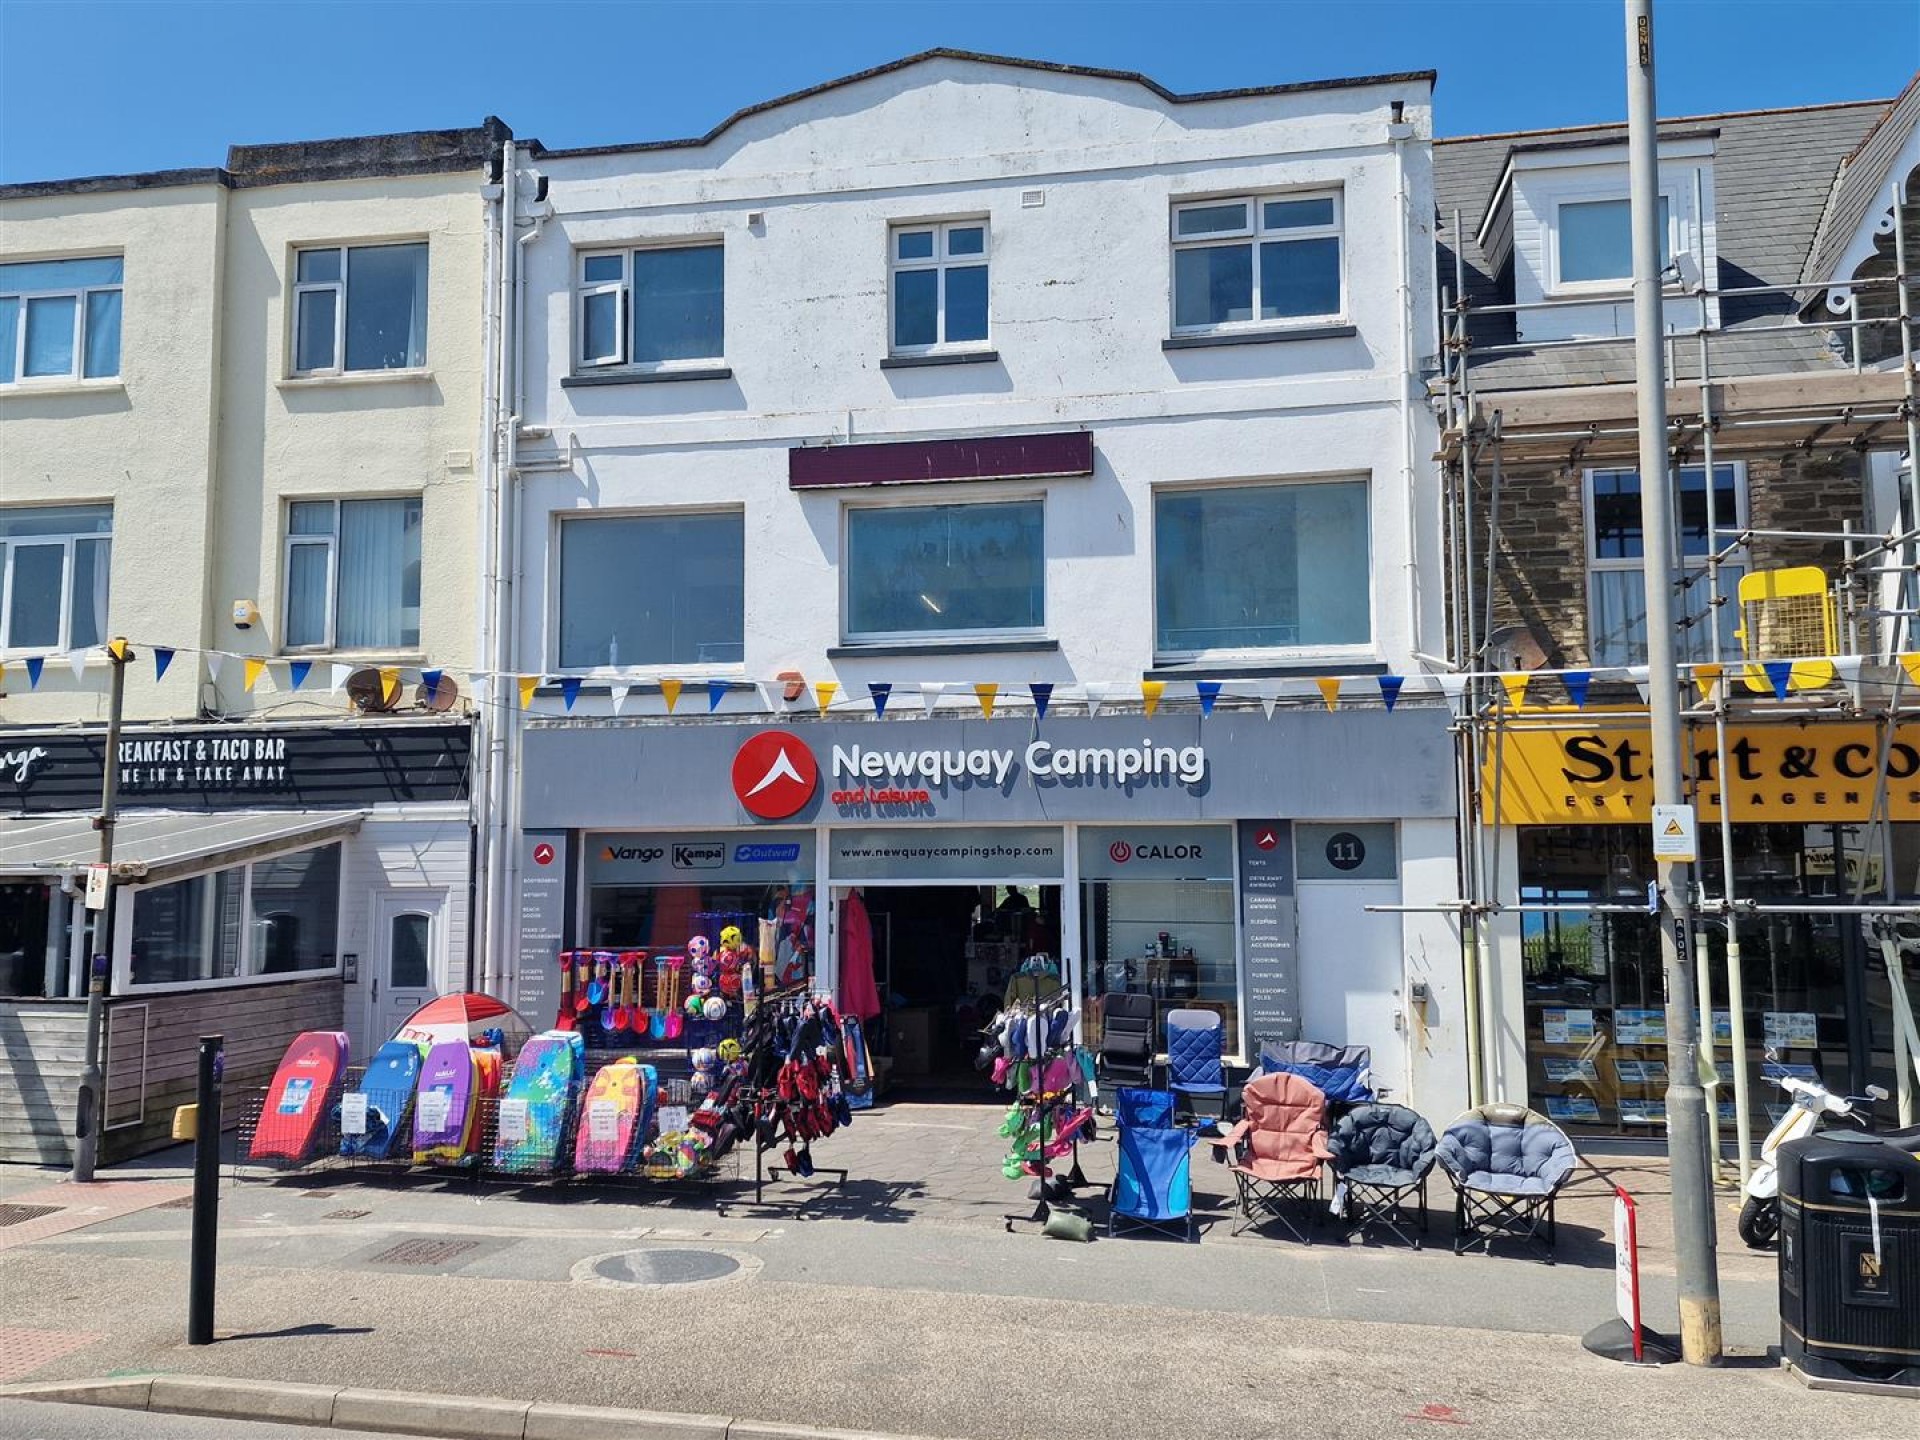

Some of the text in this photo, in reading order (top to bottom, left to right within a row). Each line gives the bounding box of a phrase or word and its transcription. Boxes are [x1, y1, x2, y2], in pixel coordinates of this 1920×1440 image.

[119, 738, 286, 763] REAKFAST & TACO BAR
[1561, 735, 1920, 781] Strt & co
[832, 738, 1204, 785] Newquay Camping
[122, 766, 285, 783] NE IN & TAKE AWAY
[832, 786, 930, 804] and Leisure
[1565, 791, 1920, 808] ESTTE AGENS
[608, 846, 665, 863] Vango
[675, 847, 722, 866] Kampa
[752, 848, 796, 859] Outwell
[841, 845, 1053, 860] www.newquaycampingshop.com
[1136, 845, 1203, 859] CALOR
[1333, 843, 1358, 861] 11
